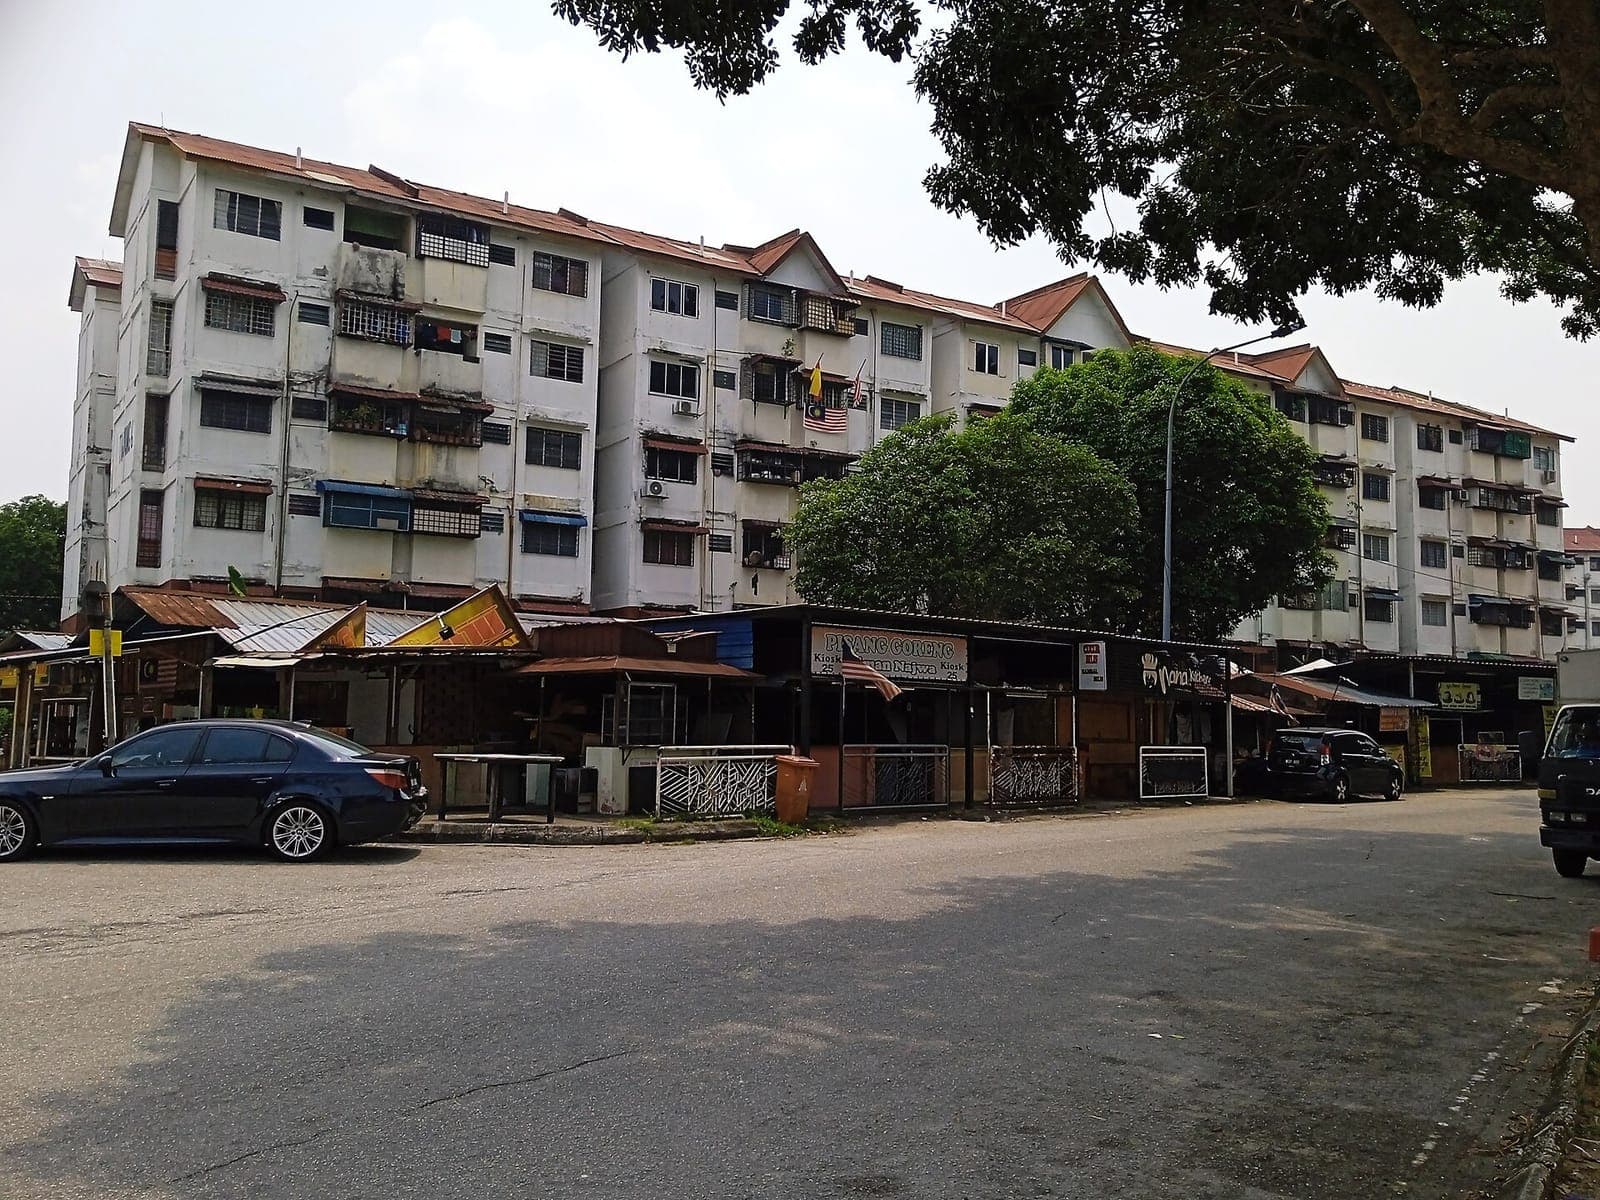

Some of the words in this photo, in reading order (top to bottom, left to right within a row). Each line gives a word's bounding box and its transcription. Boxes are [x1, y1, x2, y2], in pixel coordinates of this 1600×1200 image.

[891, 638, 955, 659] GORENG
[814, 653, 842, 663] Kiosk
[822, 664, 834, 673] 25
[894, 660, 937, 675] Najwa
[940, 661, 965, 671] Kiosk
[947, 671, 958, 680] 25
